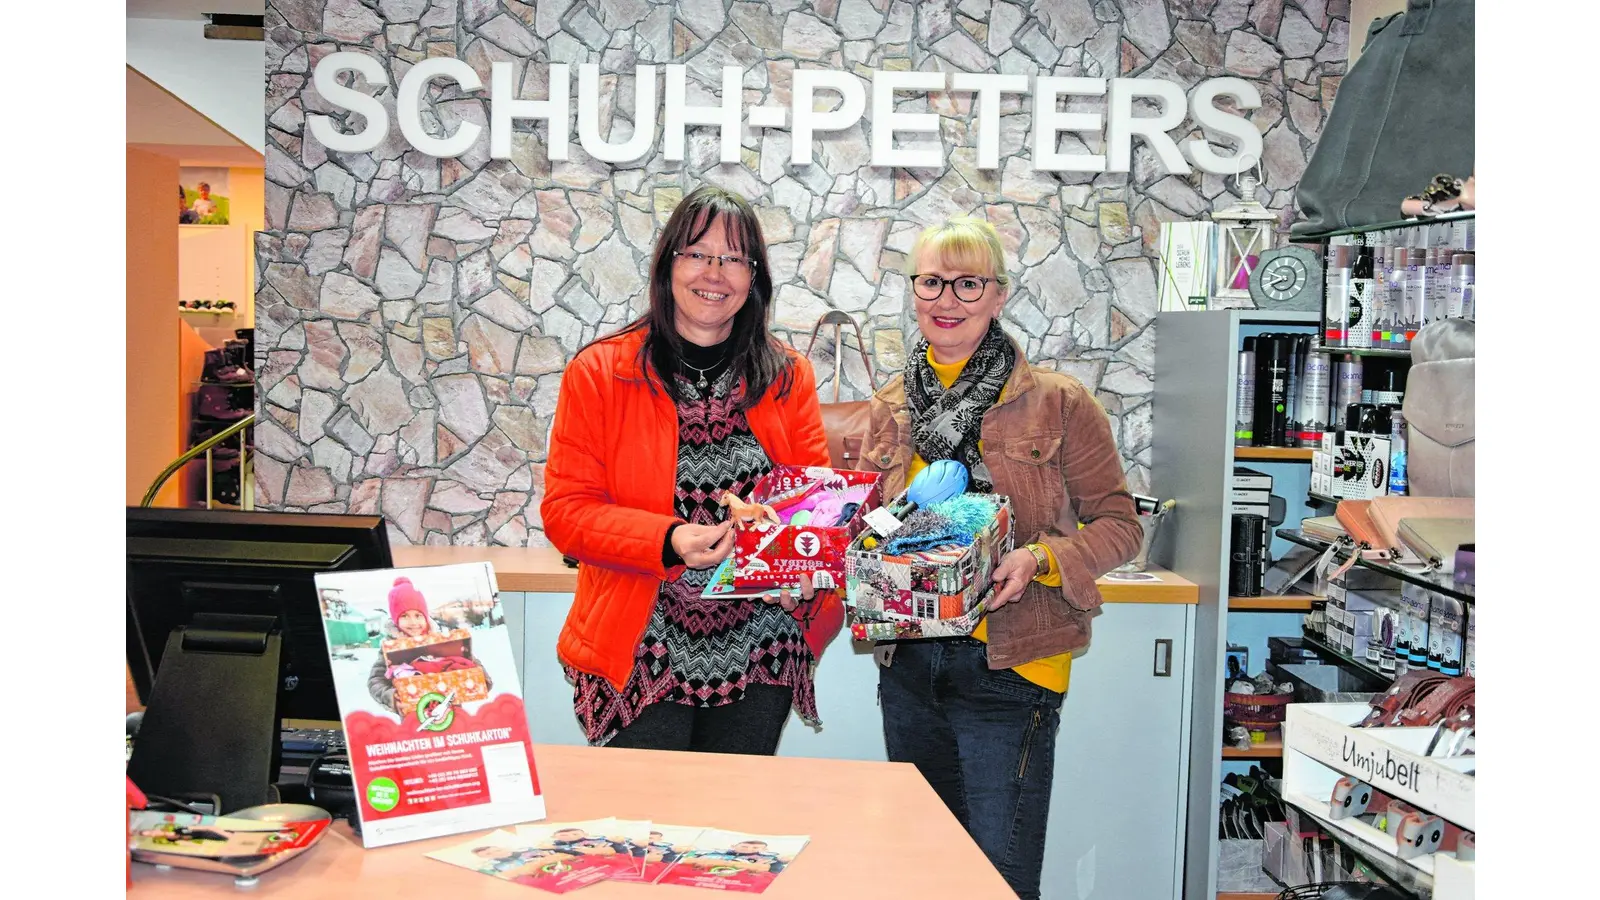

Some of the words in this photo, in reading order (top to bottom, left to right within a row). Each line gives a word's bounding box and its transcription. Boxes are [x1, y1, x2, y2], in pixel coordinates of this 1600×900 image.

[307, 51, 1264, 175] SCHUH-PETERS
[365, 738, 432, 757] WEIHNACHTEN
[433, 736, 445, 749] IM
[1342, 735, 1421, 793] Umjubelt
